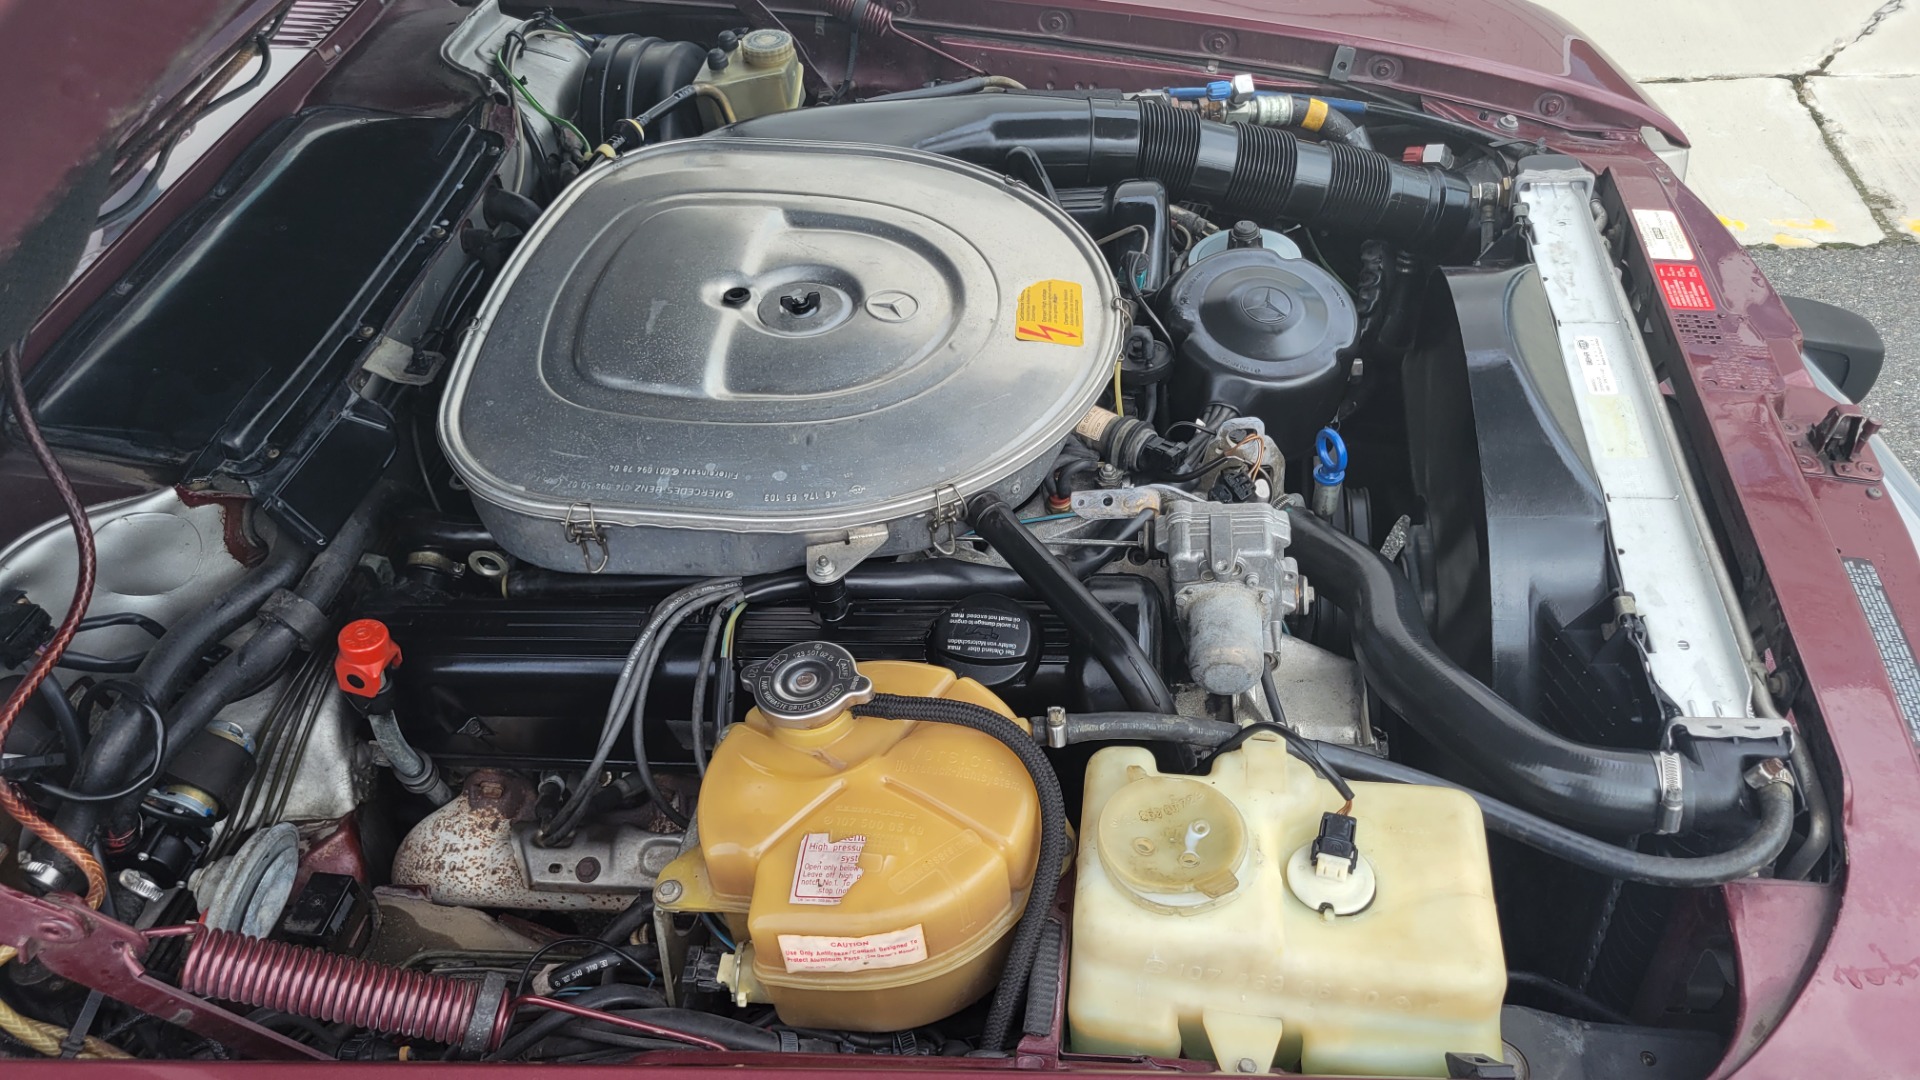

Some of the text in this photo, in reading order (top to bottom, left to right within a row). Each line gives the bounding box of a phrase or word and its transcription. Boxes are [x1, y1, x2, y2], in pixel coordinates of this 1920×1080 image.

[682, 468, 739, 480] Filtereinsatz
[764, 493, 780, 502] 103
[650, 613, 664, 630] HIGH
[622, 630, 652, 679] TEMPERATURE
[747, 665, 761, 678] 120
[836, 816, 856, 828] 107
[860, 818, 884, 831] 500
[809, 842, 828, 852] High
[841, 854, 859, 863] syst
[804, 863, 860, 872] Open only below
[802, 870, 823, 878] Leave
[838, 871, 853, 880] high
[817, 887, 833, 895] stop
[830, 940, 869, 948] CAUTION
[799, 949, 813, 957] Only
[879, 942, 908, 953] Designed
[810, 955, 842, 963] Aluminum
[1177, 962, 1224, 981] 107
[1300, 979, 1332, 1000] 06
